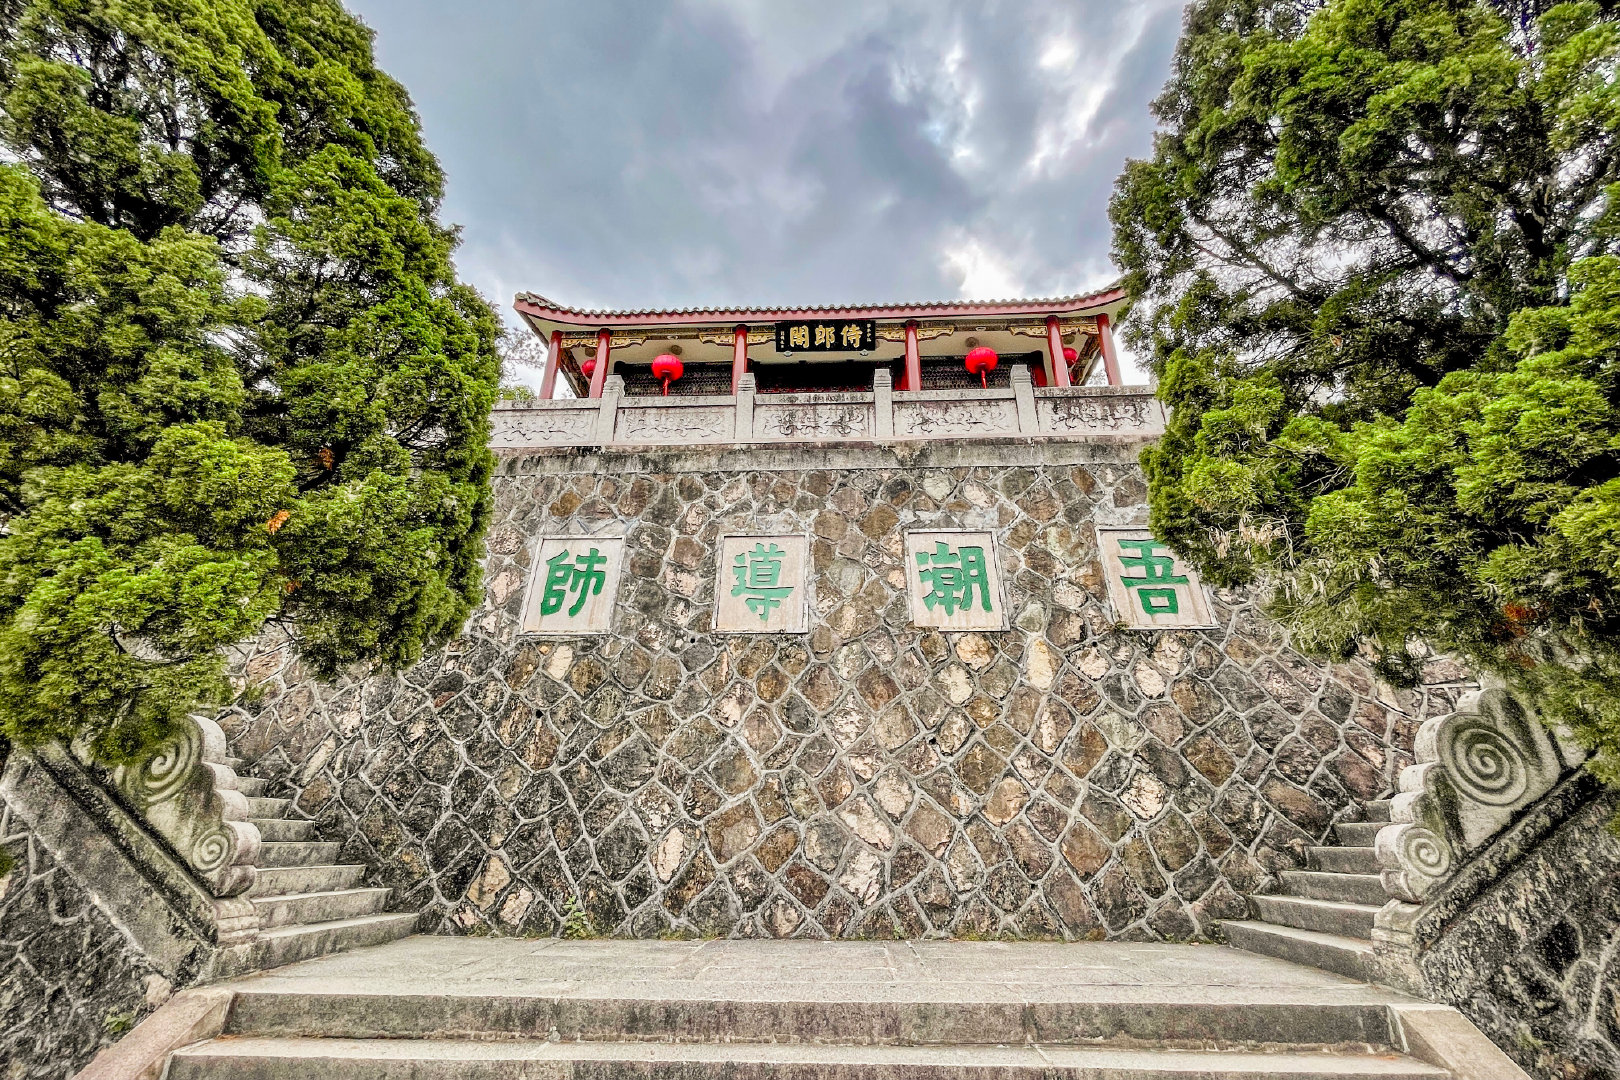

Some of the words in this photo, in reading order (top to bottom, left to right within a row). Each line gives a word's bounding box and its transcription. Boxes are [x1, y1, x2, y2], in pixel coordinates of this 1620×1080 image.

[540, 547, 608, 619] 師
[731, 543, 794, 622] 導
[915, 541, 994, 617] 潮
[1117, 538, 1190, 616] 吾
